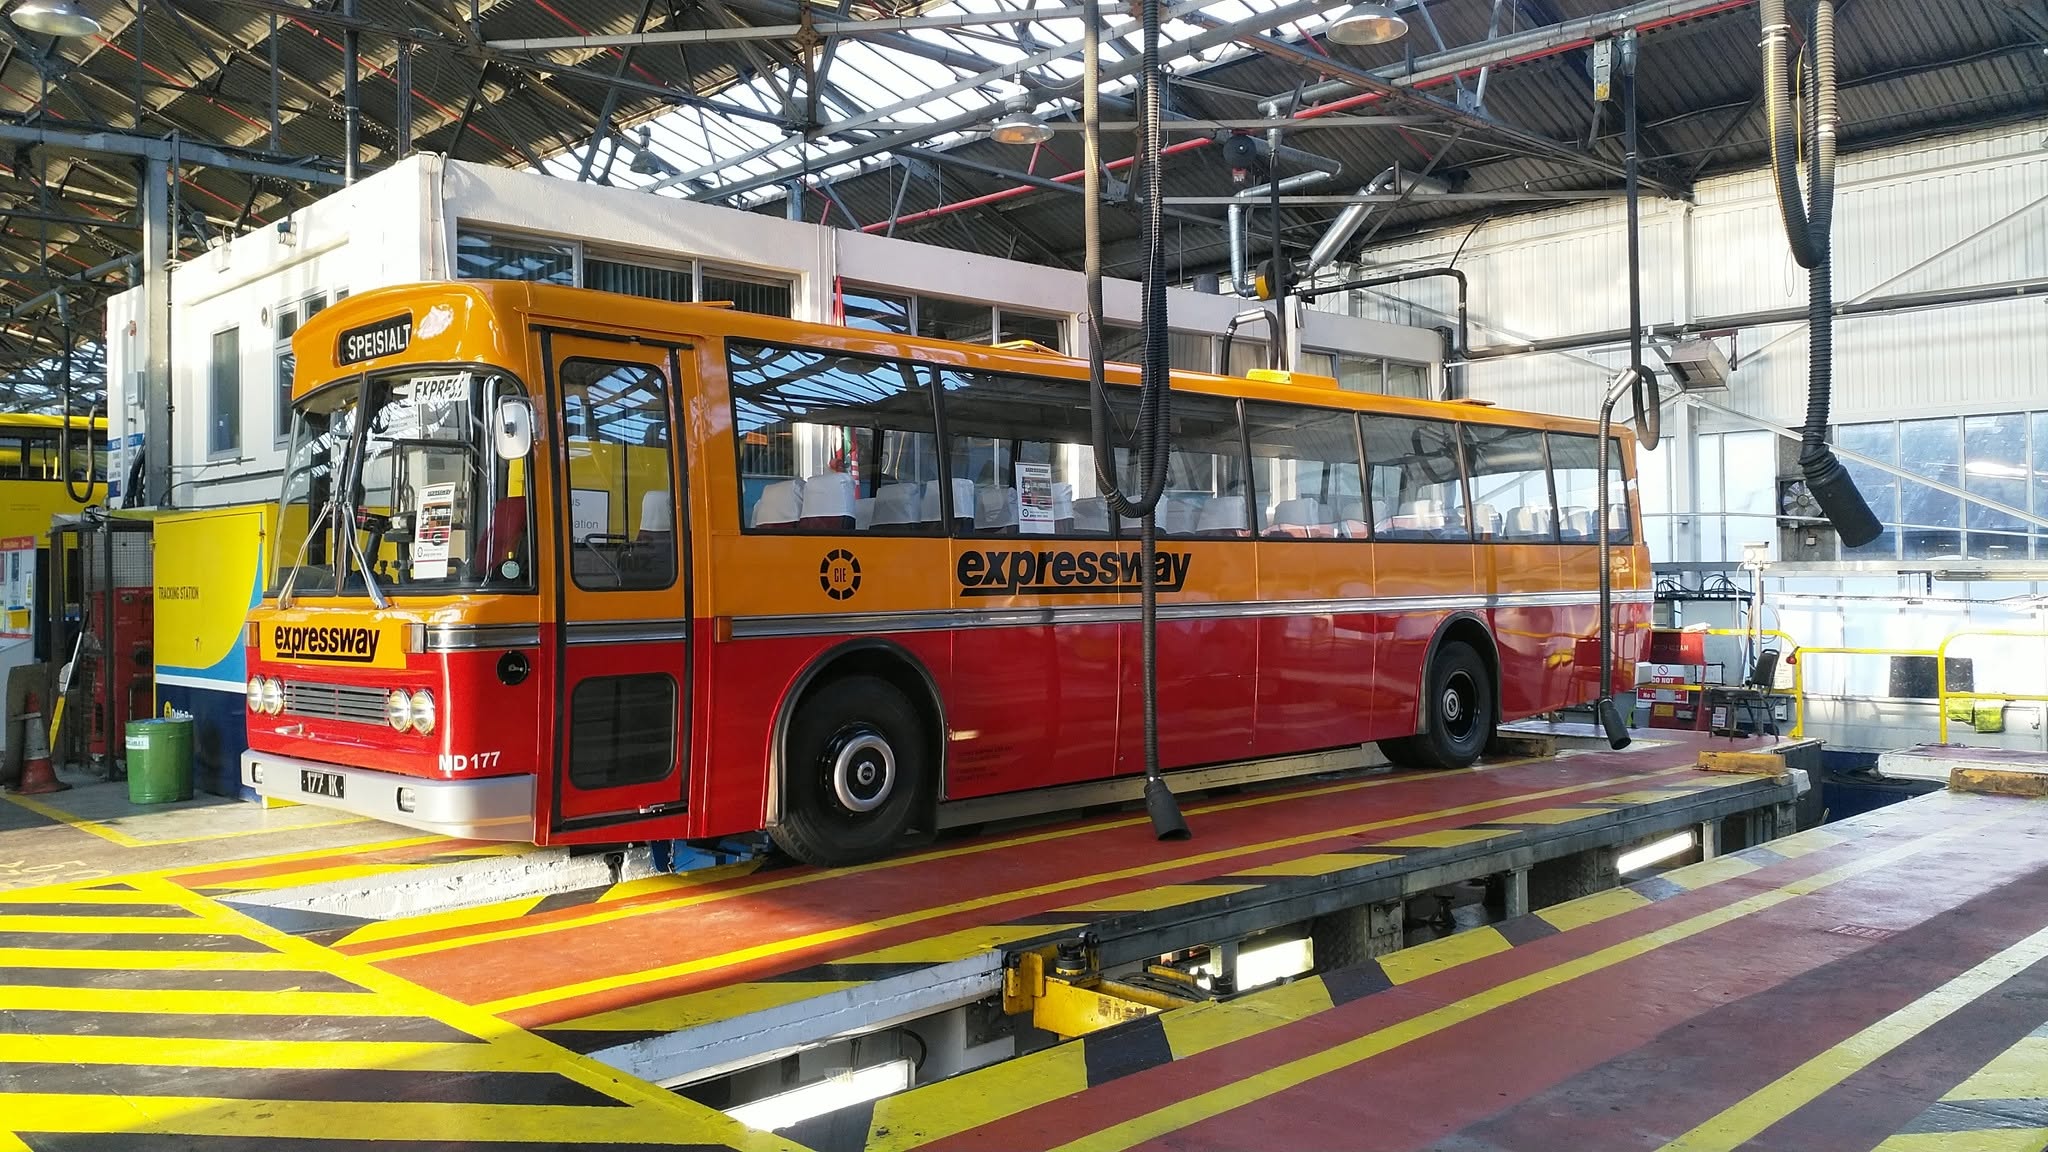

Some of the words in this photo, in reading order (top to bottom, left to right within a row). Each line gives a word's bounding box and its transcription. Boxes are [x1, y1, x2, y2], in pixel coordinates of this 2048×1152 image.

[348, 324, 411, 360] SPEISIALT
[834, 567, 847, 583] CIE
[957, 550, 1192, 596] expressway
[158, 586, 179, 600] TRACKING
[180, 586, 200, 600] STATION
[274, 625, 381, 663] expressway
[438, 754, 468, 771] MD
[470, 751, 501, 769] 177
[307, 771, 324, 793] 177
